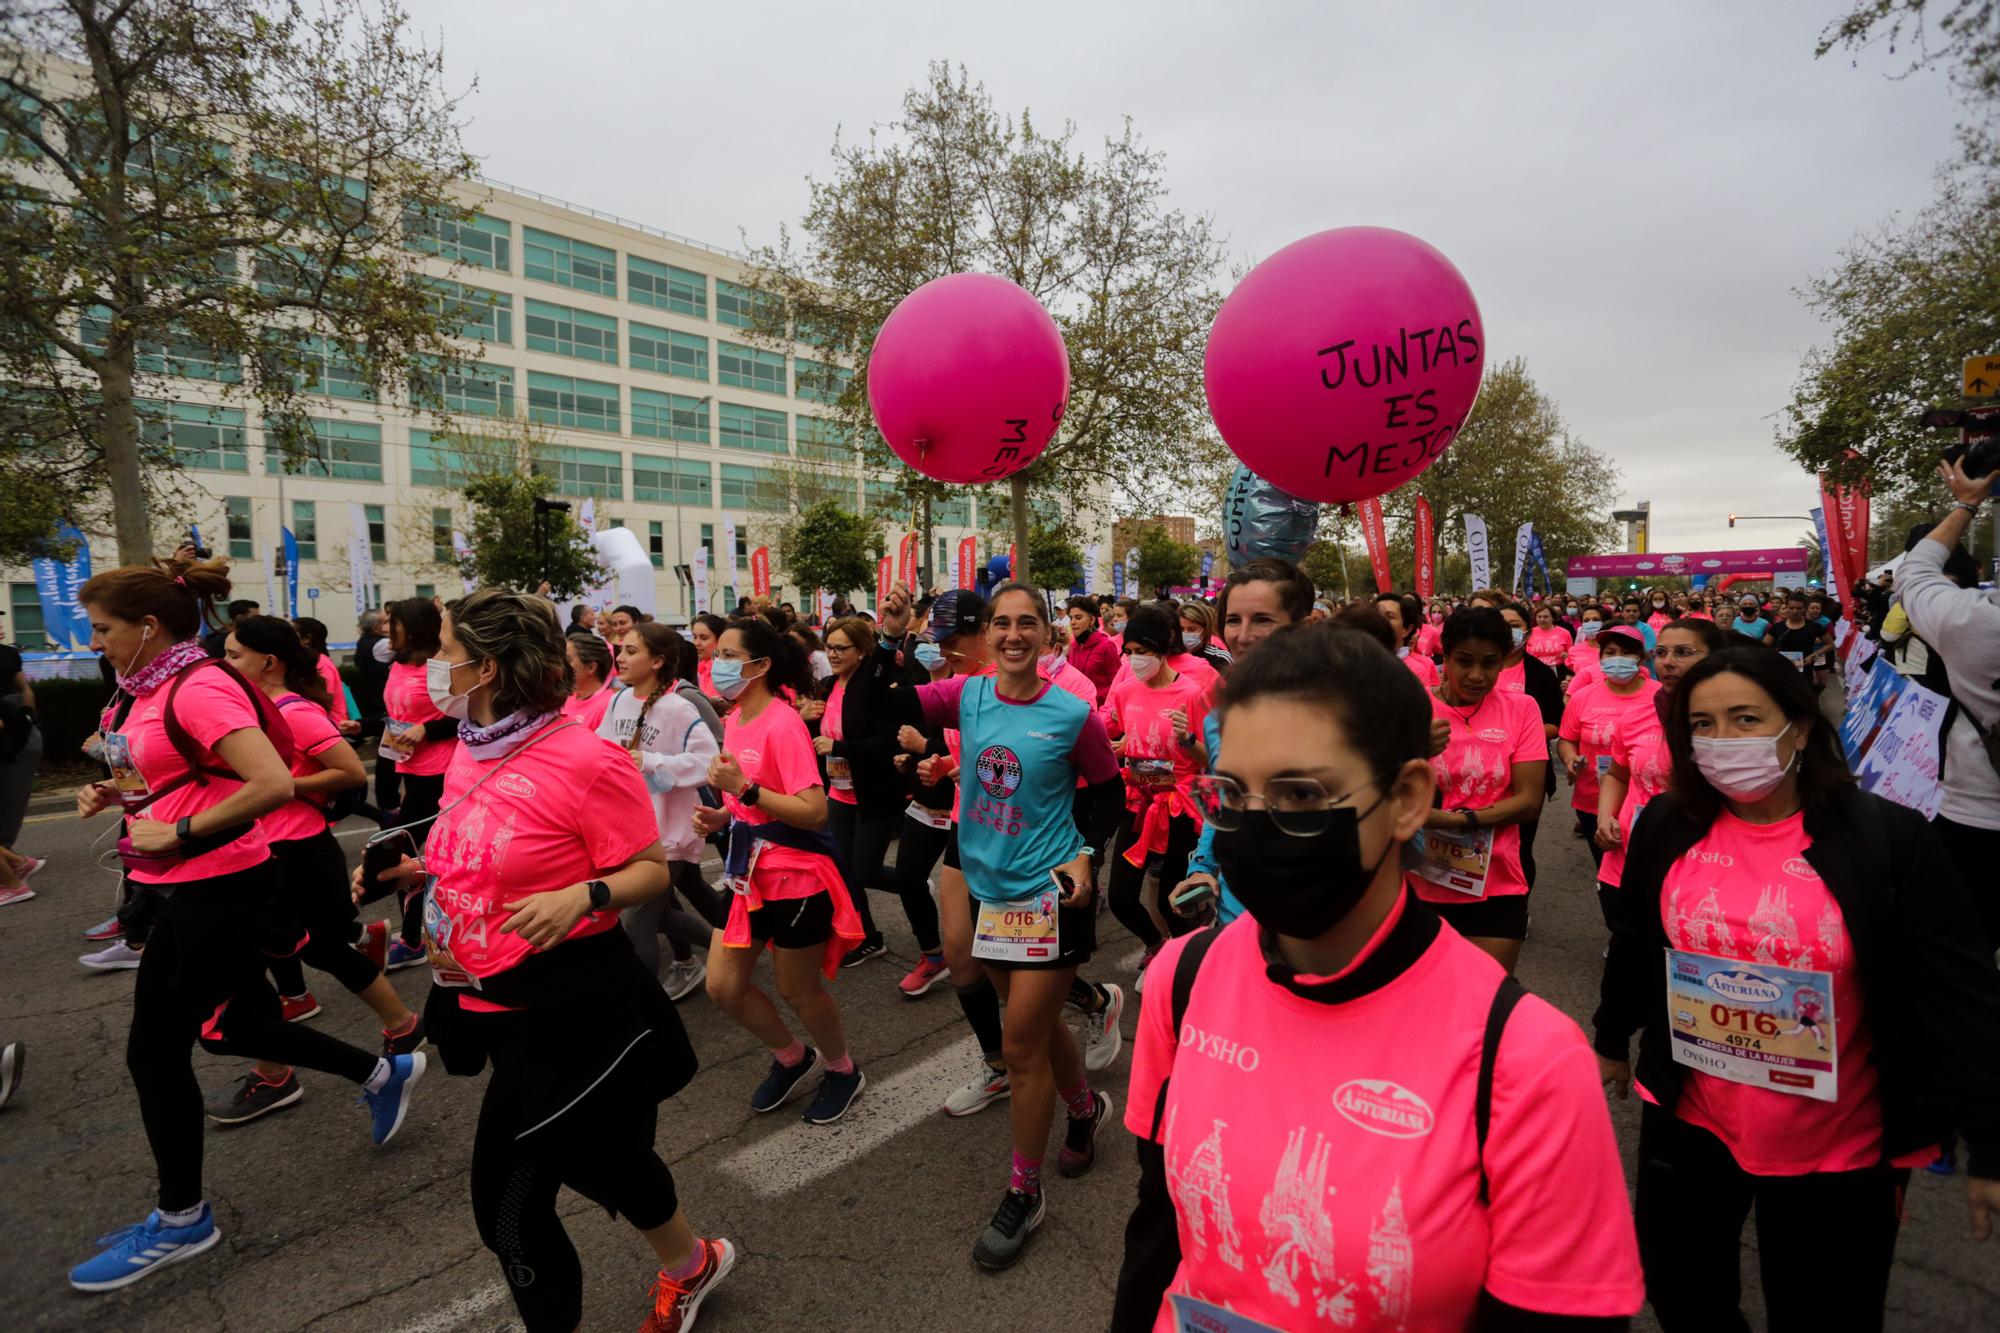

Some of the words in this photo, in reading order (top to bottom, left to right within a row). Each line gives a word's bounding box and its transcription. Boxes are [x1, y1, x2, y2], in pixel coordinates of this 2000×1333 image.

[1317, 319, 1479, 390] JUNTAS
[1384, 389, 1439, 429] ES
[756, 553, 766, 593] Santander
[963, 544, 971, 590] Santander
[434, 886, 499, 916] ORSAL
[1004, 911, 1034, 926] 016
[1710, 1003, 1777, 1036] 016
[1179, 1023, 1260, 1072] OYSHO
[1696, 1038, 1733, 1055] CARRERA
[1735, 1048, 1746, 1057] DE
[1749, 1051, 1760, 1060] LA
[1763, 1056, 1796, 1067] MUJER
[1725, 1034, 1762, 1049] 4974
[1683, 1048, 1727, 1070] OYSHO
